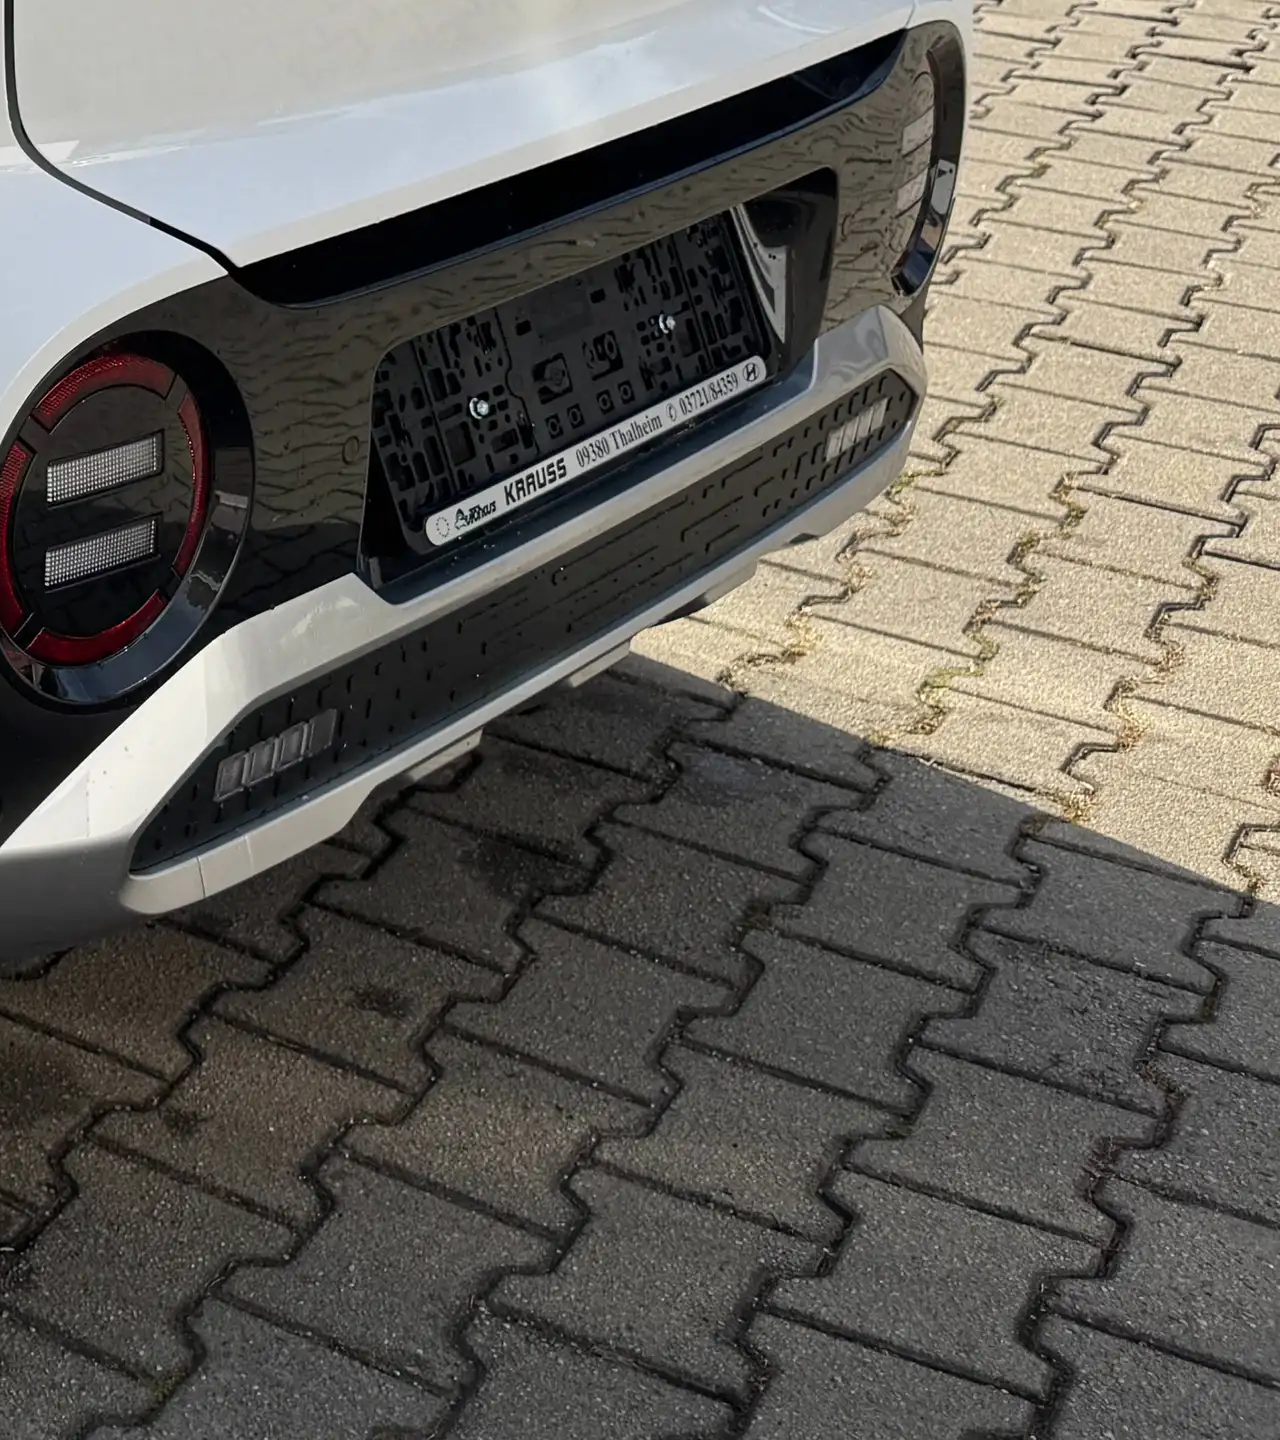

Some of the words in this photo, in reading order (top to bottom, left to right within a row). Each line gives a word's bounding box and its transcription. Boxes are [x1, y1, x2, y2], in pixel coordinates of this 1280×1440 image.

[503, 457, 567, 506] KRAUSS
[575, 437, 611, 468] 09380
[609, 414, 663, 451] Thalheim
[678, 372, 739, 416] 03721/84359
